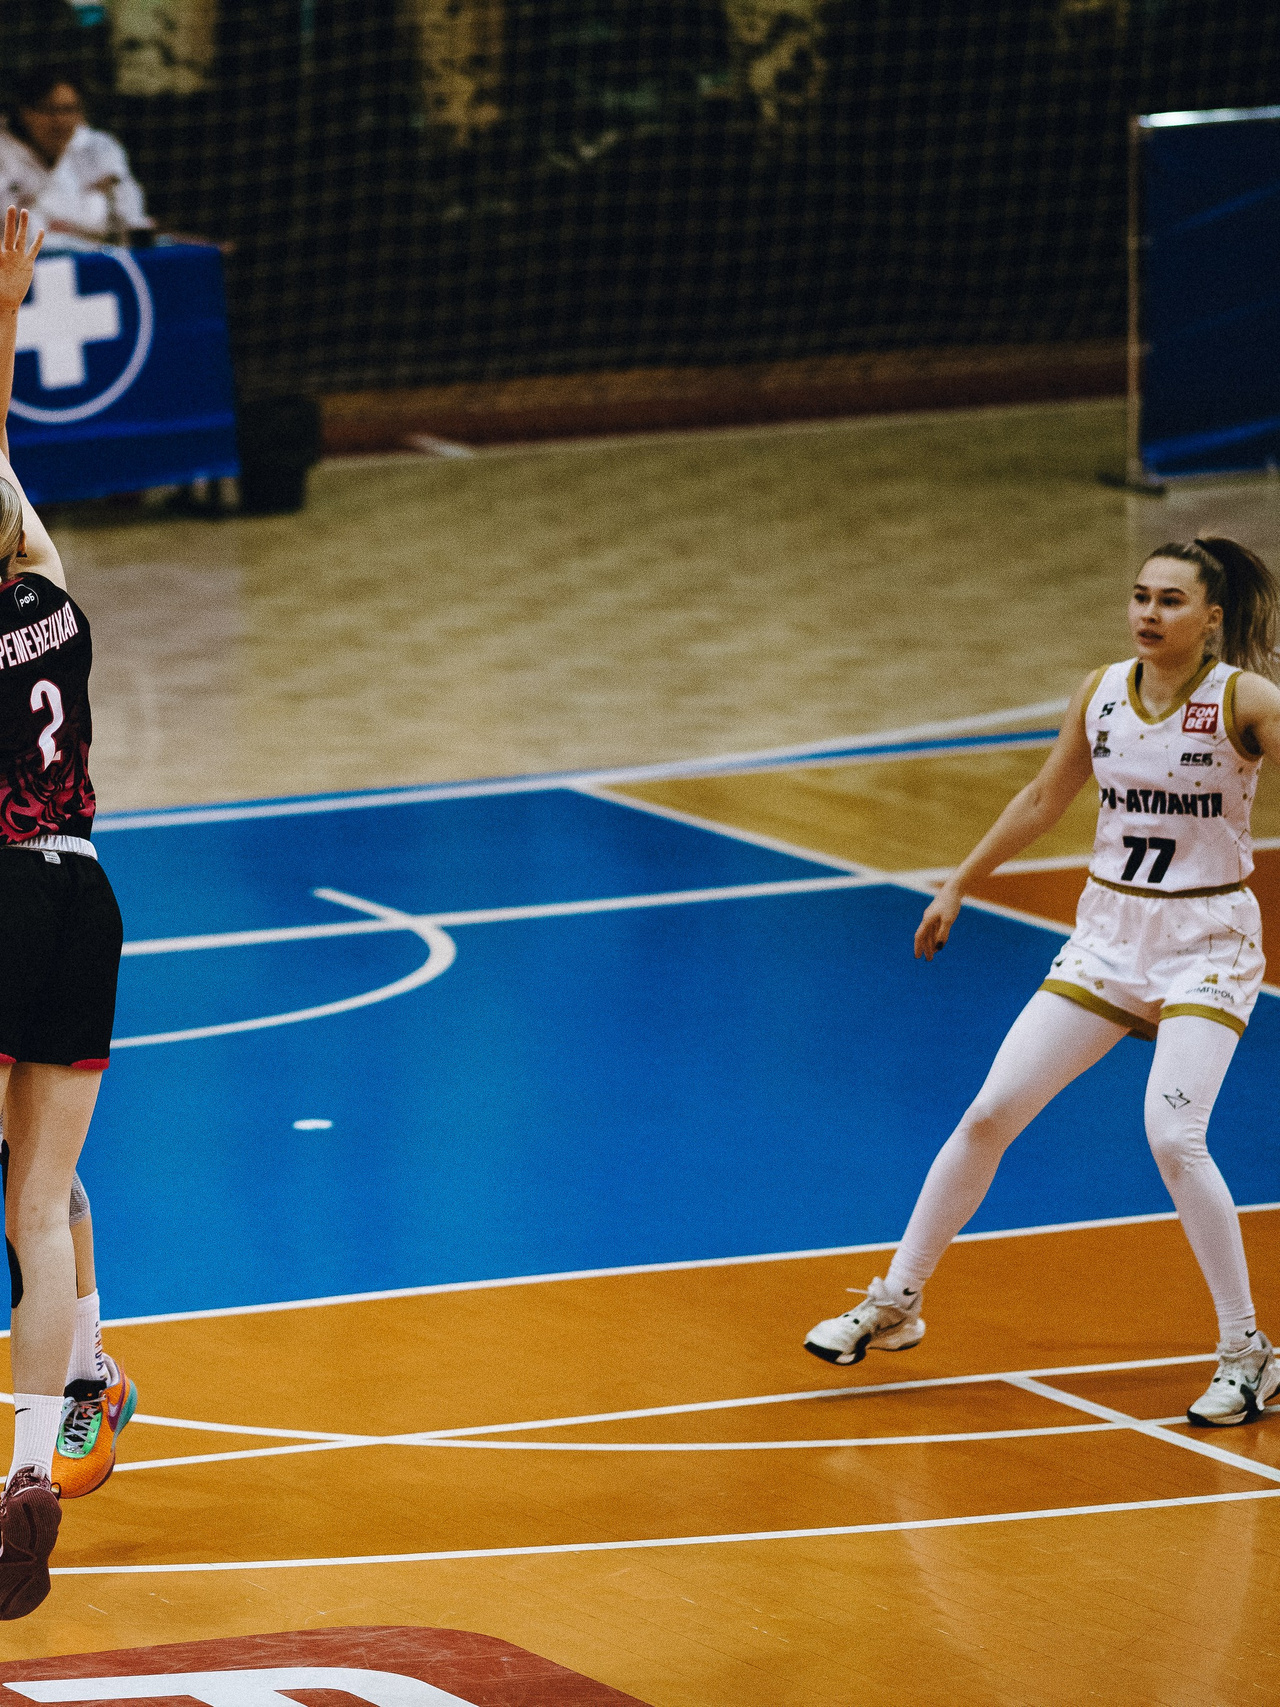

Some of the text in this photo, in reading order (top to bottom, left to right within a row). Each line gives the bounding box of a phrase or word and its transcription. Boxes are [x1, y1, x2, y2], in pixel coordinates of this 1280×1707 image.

[19, 592, 35, 608] РФБ
[1187, 706, 1218, 718] FON
[29, 679, 65, 771] 2
[1184, 717, 1216, 730] BET
[1121, 835, 1176, 884] 77
